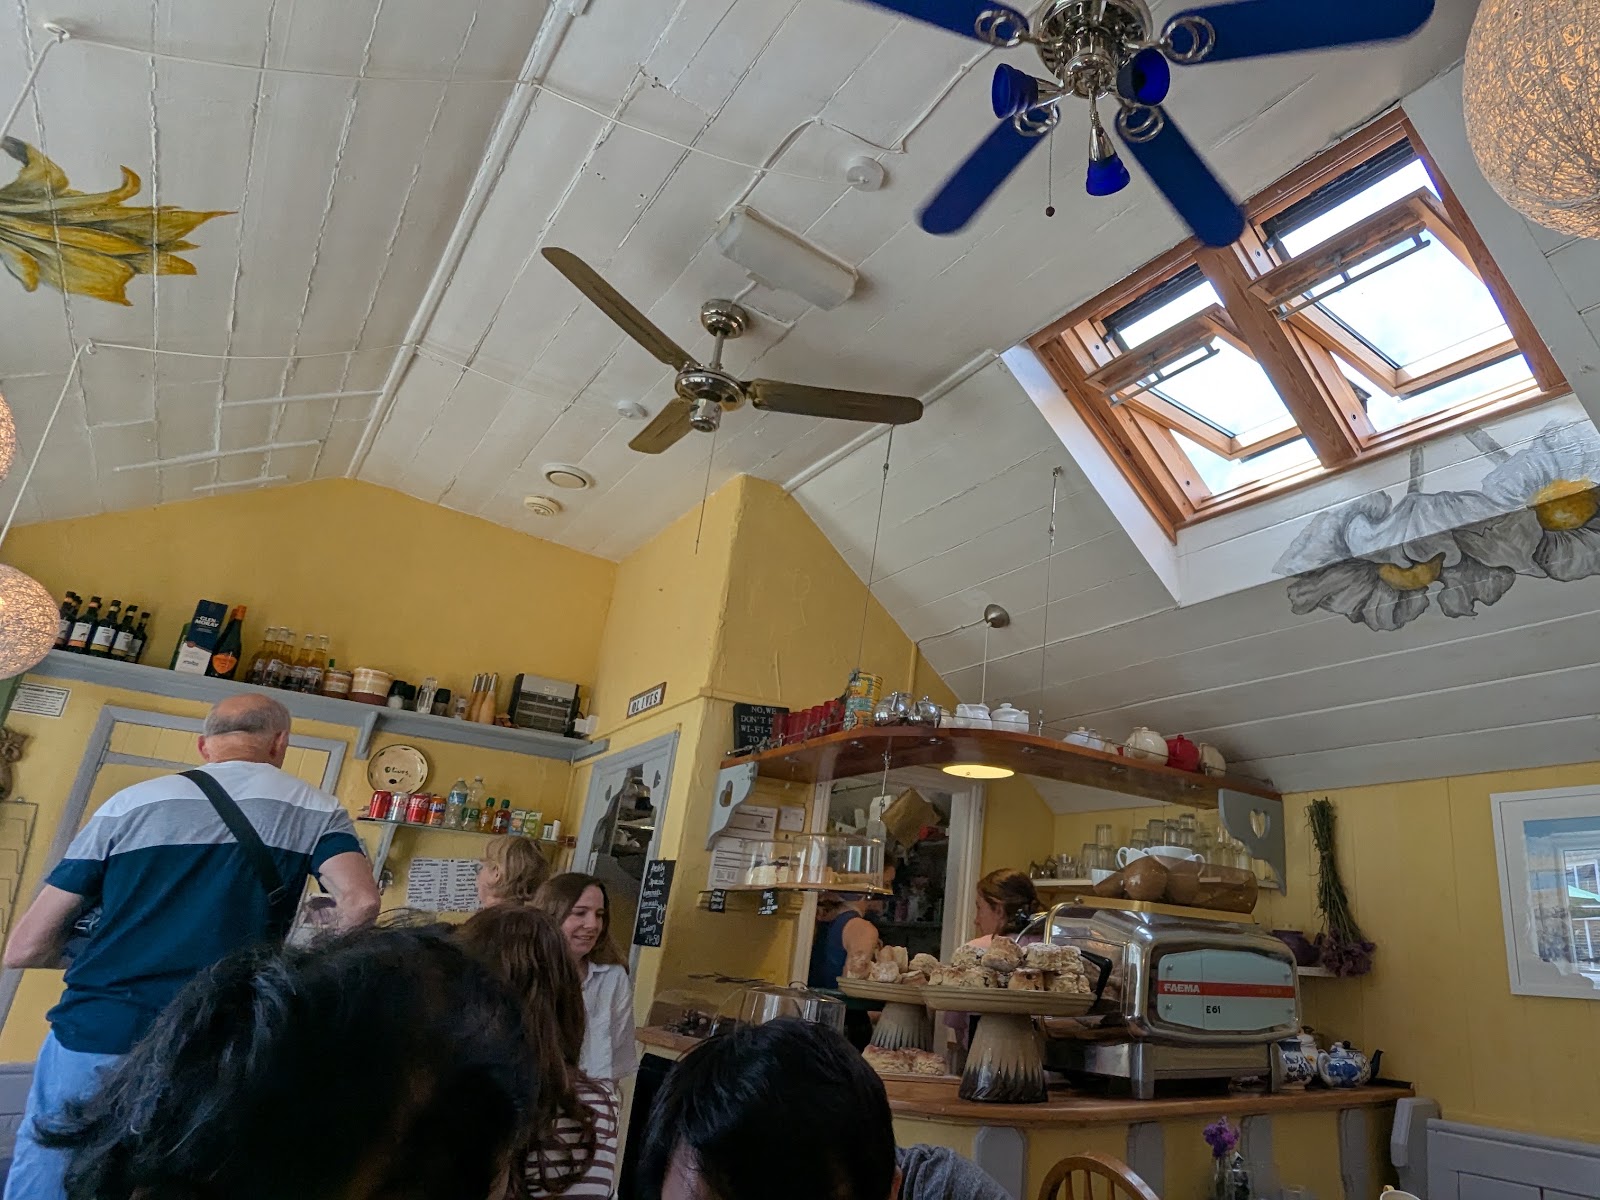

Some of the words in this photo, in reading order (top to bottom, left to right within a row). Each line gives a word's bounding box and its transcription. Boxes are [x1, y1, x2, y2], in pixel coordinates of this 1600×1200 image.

[194, 619, 219, 628] MORAY
[631, 691, 659, 713] OLIVES
[740, 715, 766, 724] DON'T
[747, 735, 760, 743] TO
[1163, 983, 1200, 993] FAEMA
[1206, 1005, 1221, 1014] E61
